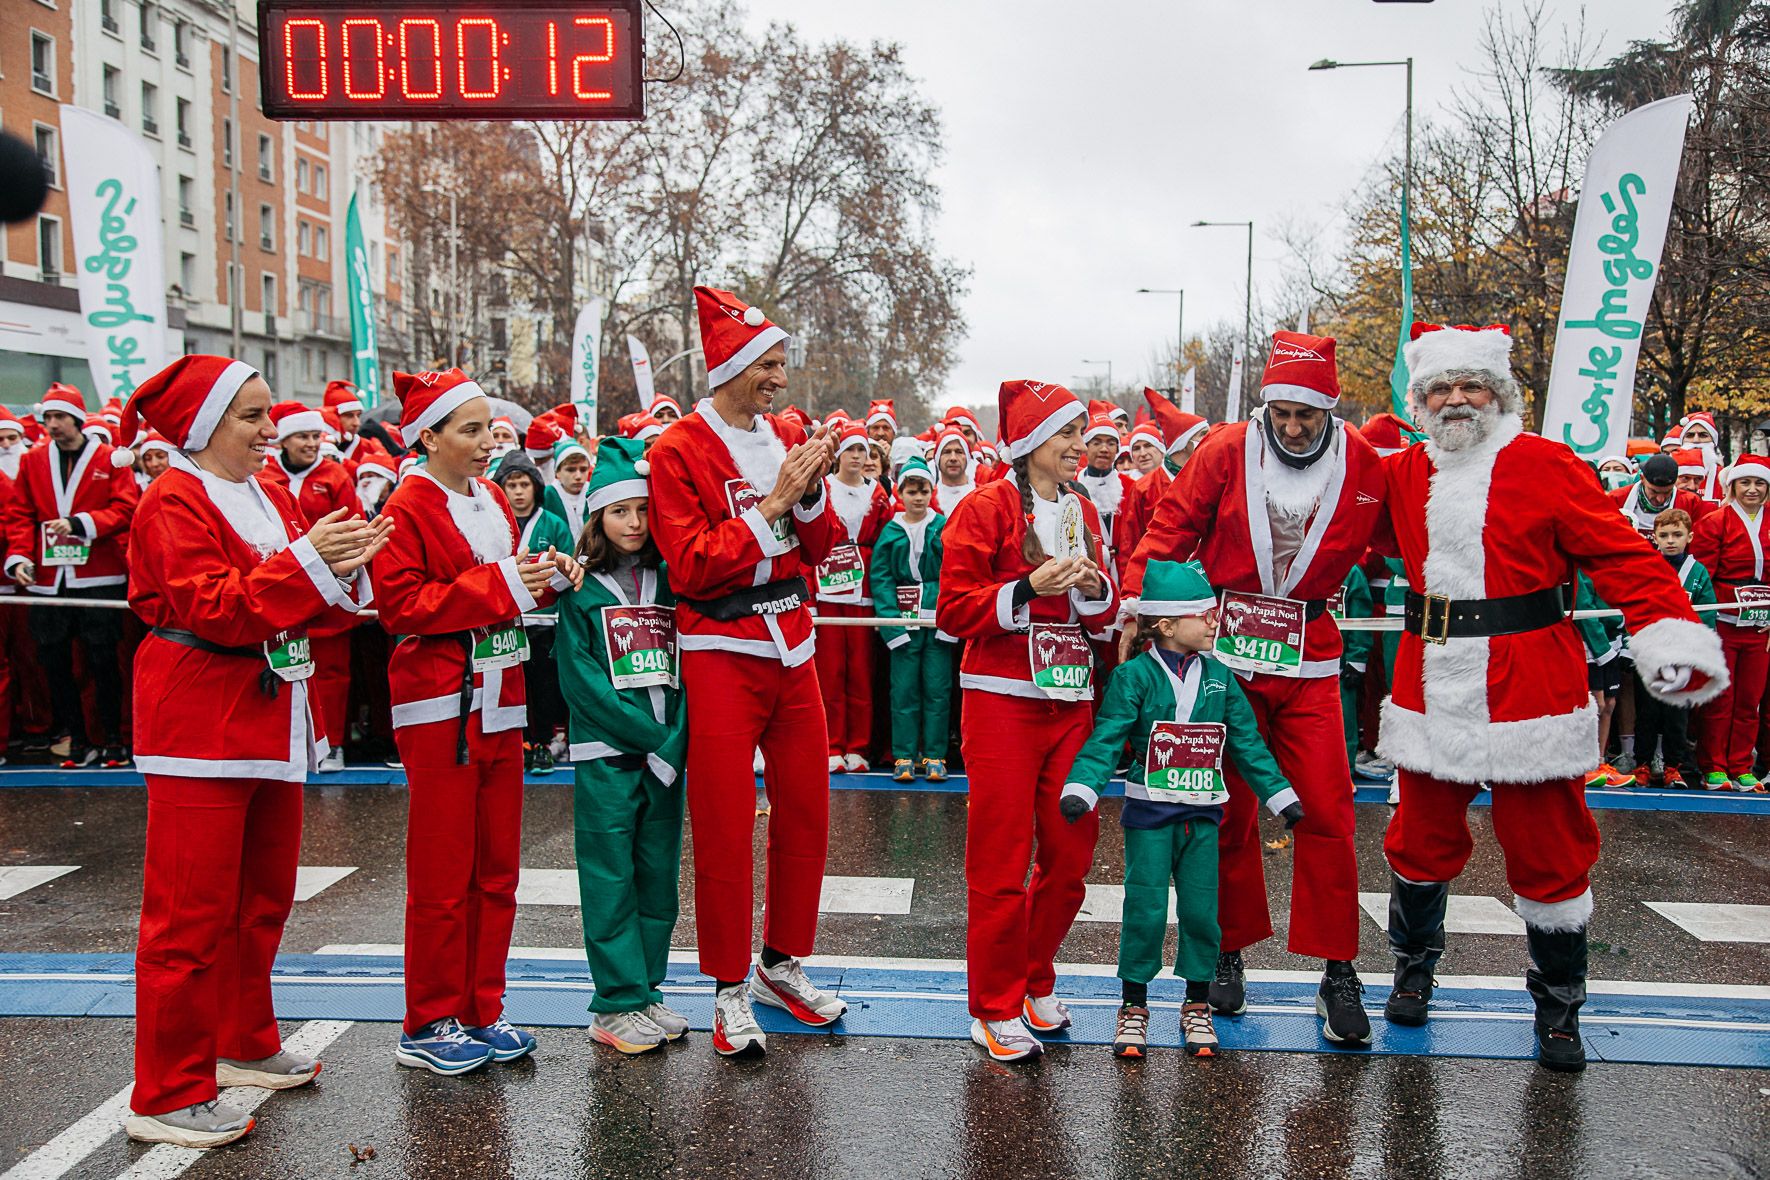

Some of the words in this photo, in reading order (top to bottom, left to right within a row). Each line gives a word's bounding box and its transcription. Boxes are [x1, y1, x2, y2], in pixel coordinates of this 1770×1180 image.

[284, 17, 614, 101] 00:00:12
[1564, 173, 1654, 340] Inglés
[1563, 346, 1622, 454] Corte
[829, 570, 855, 585] 2961
[1252, 605, 1276, 618] Papá
[1277, 609, 1298, 621] Noel
[1748, 609, 1769, 621] 3133
[492, 628, 519, 655] 940
[1233, 636, 1282, 662] 9410
[1181, 735, 1204, 747] Papá
[1205, 735, 1220, 744] Noel
[1167, 769, 1214, 791] 9408
